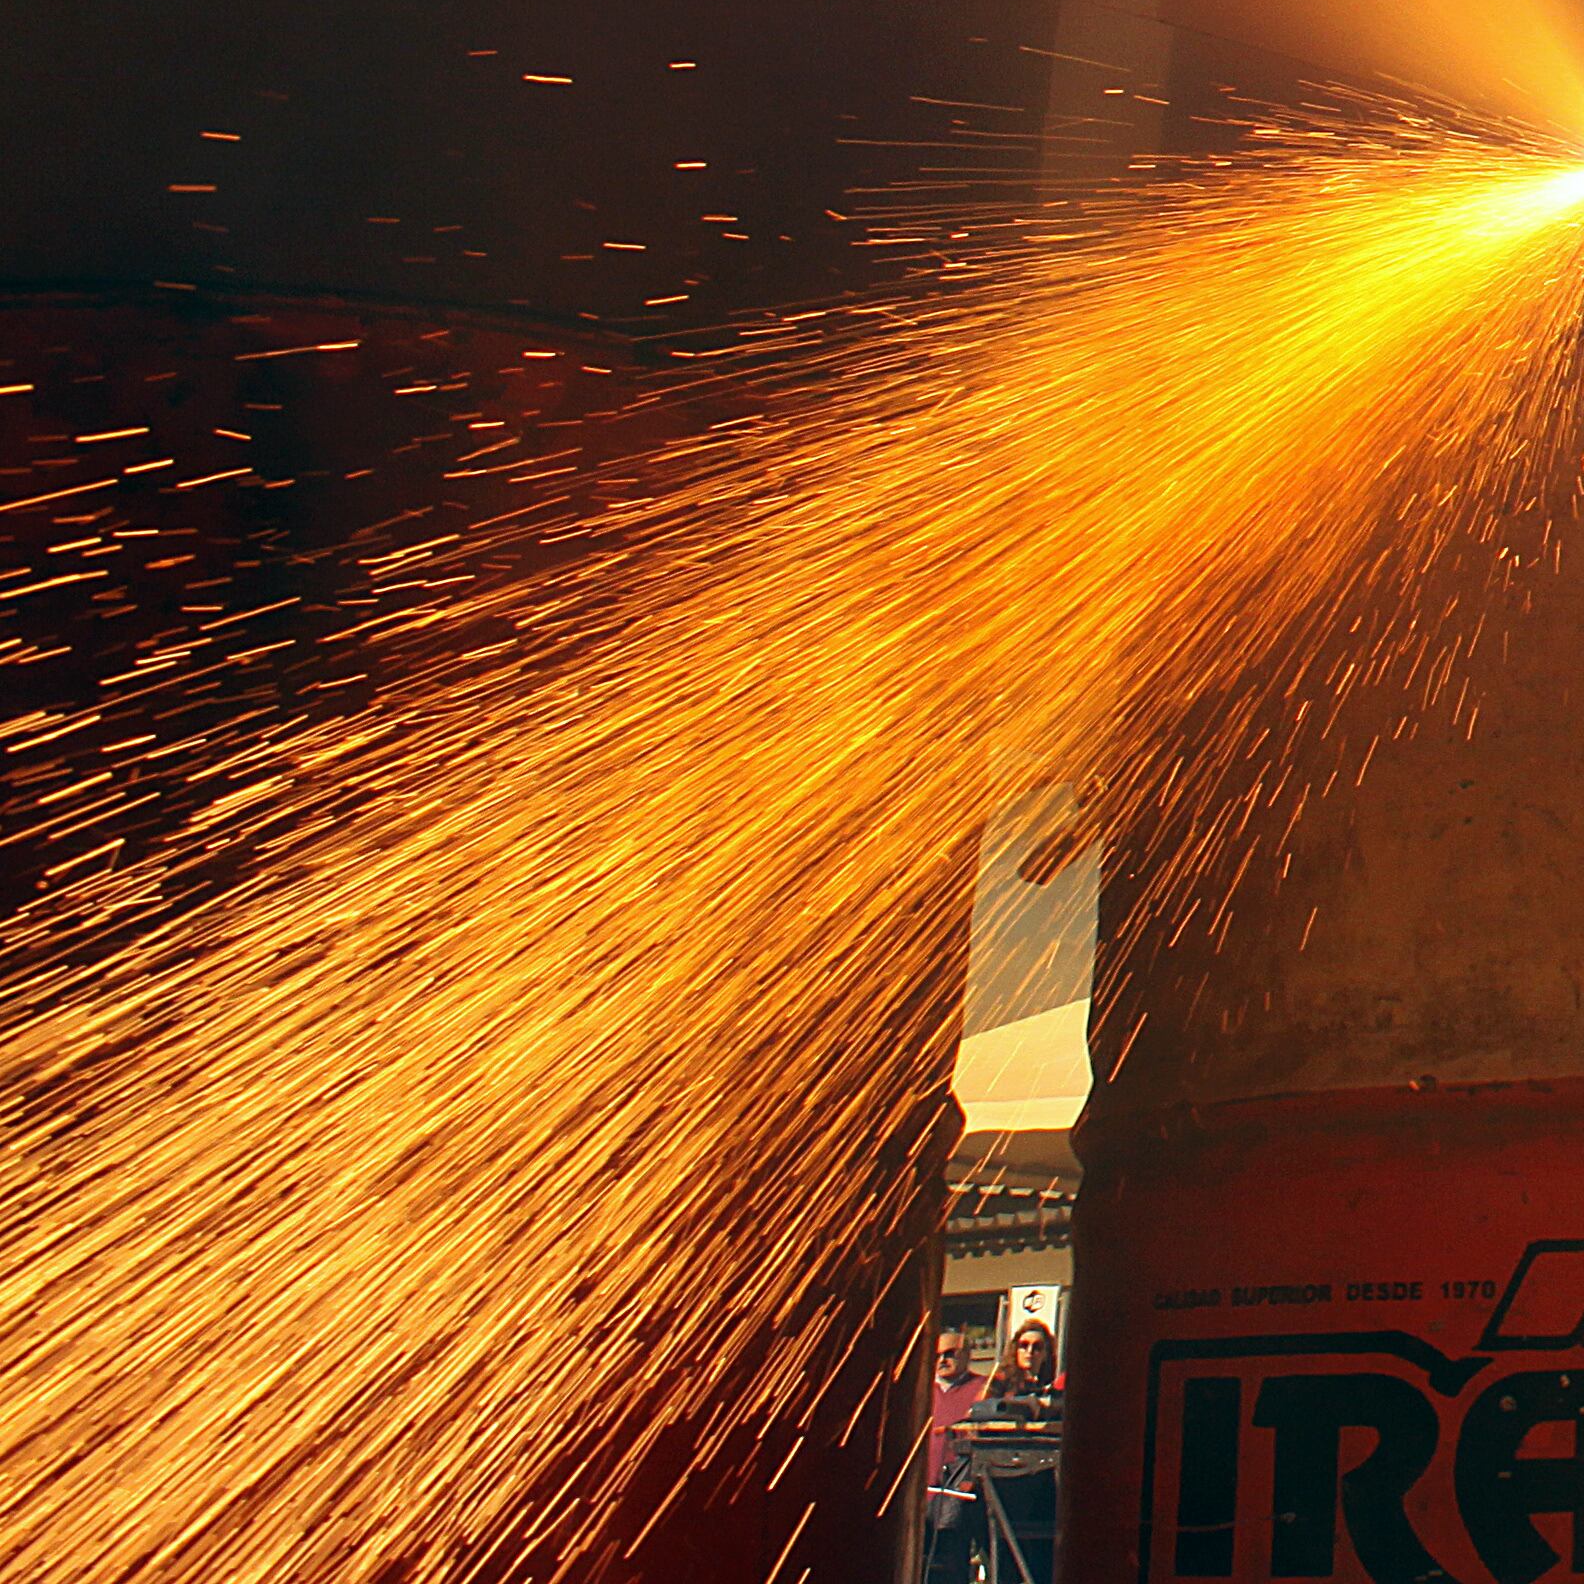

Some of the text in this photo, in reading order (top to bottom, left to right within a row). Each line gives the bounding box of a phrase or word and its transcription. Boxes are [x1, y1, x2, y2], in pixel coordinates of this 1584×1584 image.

[1231, 1282, 1332, 1307] SUPERIOR
[1345, 1281, 1422, 1301] DESDE
[1440, 1280, 1496, 1300] 1970
